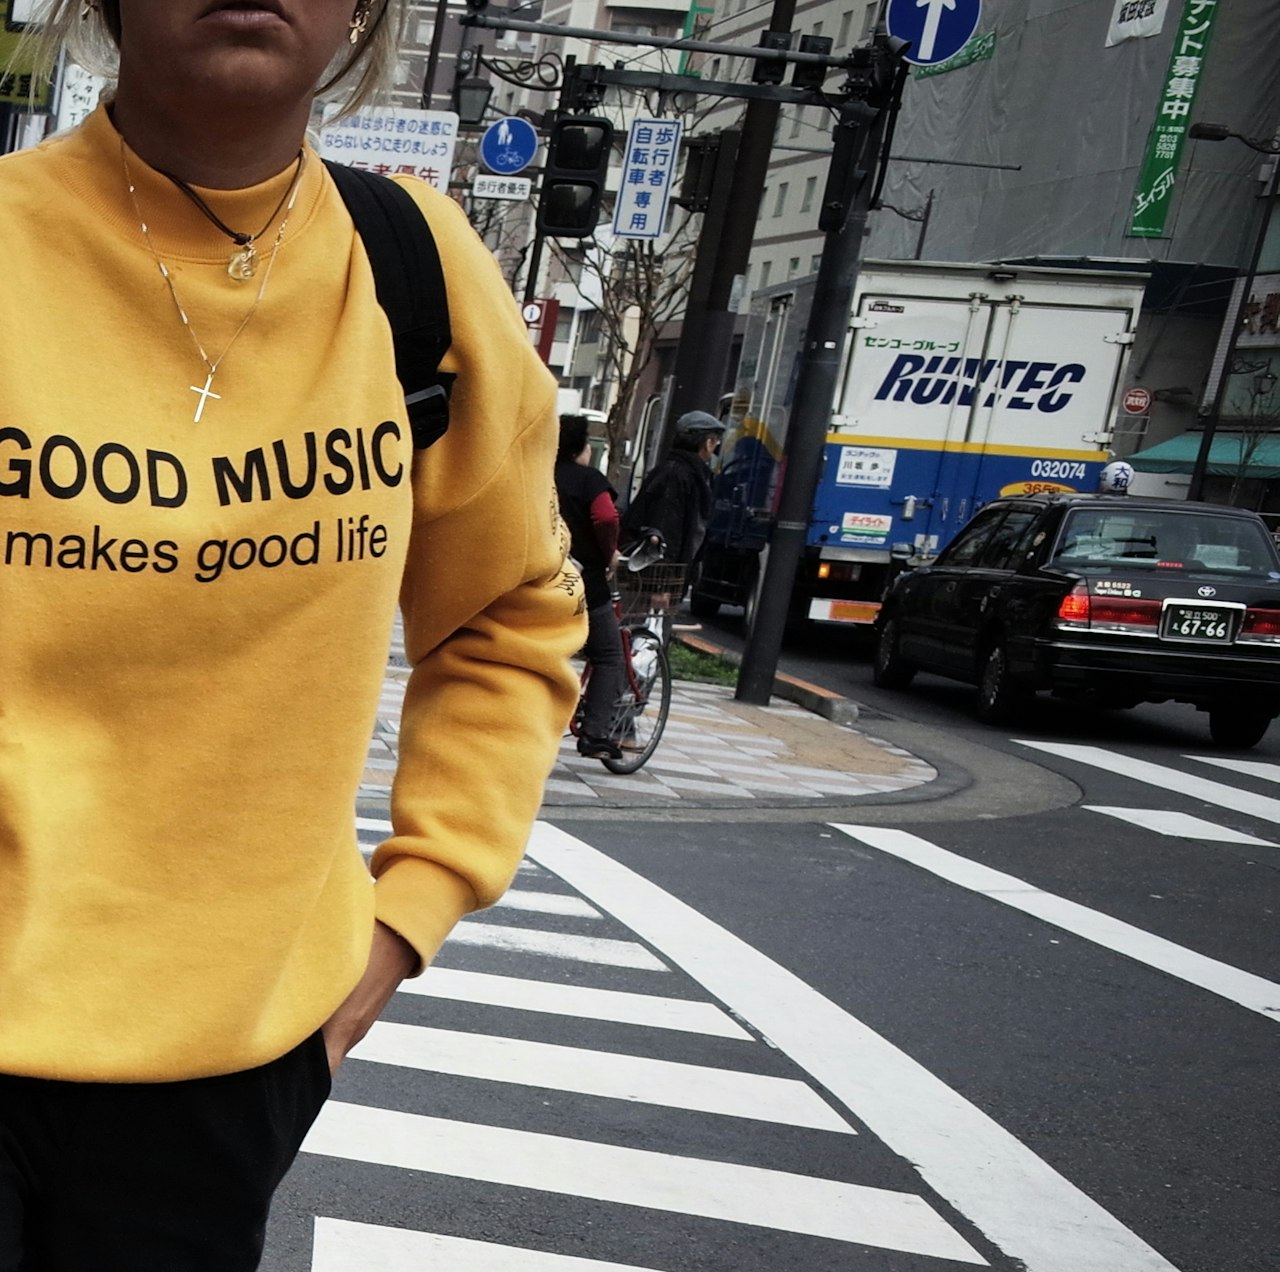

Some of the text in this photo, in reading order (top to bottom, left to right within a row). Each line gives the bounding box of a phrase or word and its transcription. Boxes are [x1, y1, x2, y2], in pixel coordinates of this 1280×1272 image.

[325, 133, 450, 157] ならないように走りましょう
[627, 127, 653, 186] 自転車
[648, 127, 674, 187] 歩行者
[476, 180, 529, 196] 歩行者優先
[629, 191, 653, 231] 専用
[864, 336, 960, 353] センコーグループ
[874, 353, 1087, 413] RUNTEC
[211, 420, 404, 507] MUSIC
[1030, 459, 1087, 480] 032074
[1112, 466, 1130, 489] 大和
[4, 514, 389, 583] makes good life
[1202, 611, 1219, 621] 500
[1180, 620, 1227, 638] 67-66
